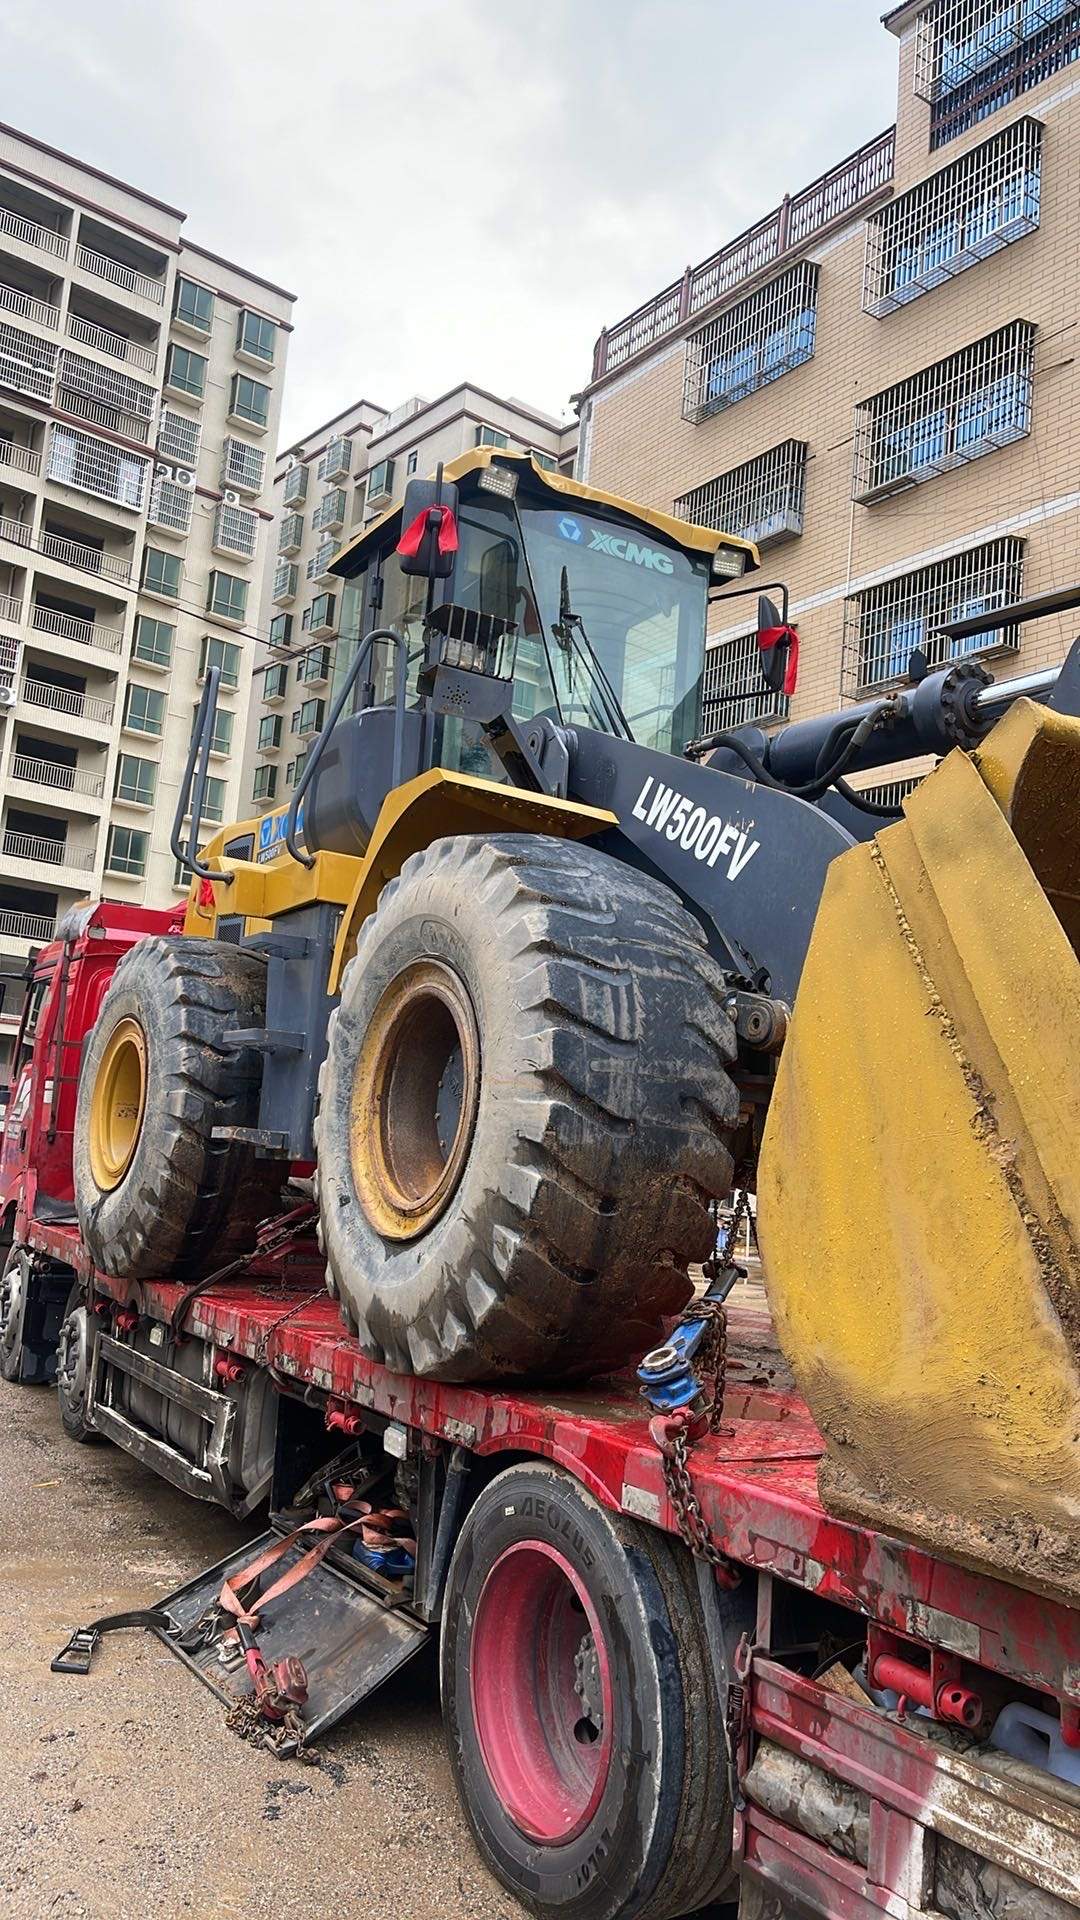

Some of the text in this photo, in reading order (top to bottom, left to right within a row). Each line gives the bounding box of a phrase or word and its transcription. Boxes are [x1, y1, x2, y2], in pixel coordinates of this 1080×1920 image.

[587, 528, 674, 575] XCMG
[632, 776, 760, 881] LW500FV
[521, 1497, 596, 1571] AEOLUS
